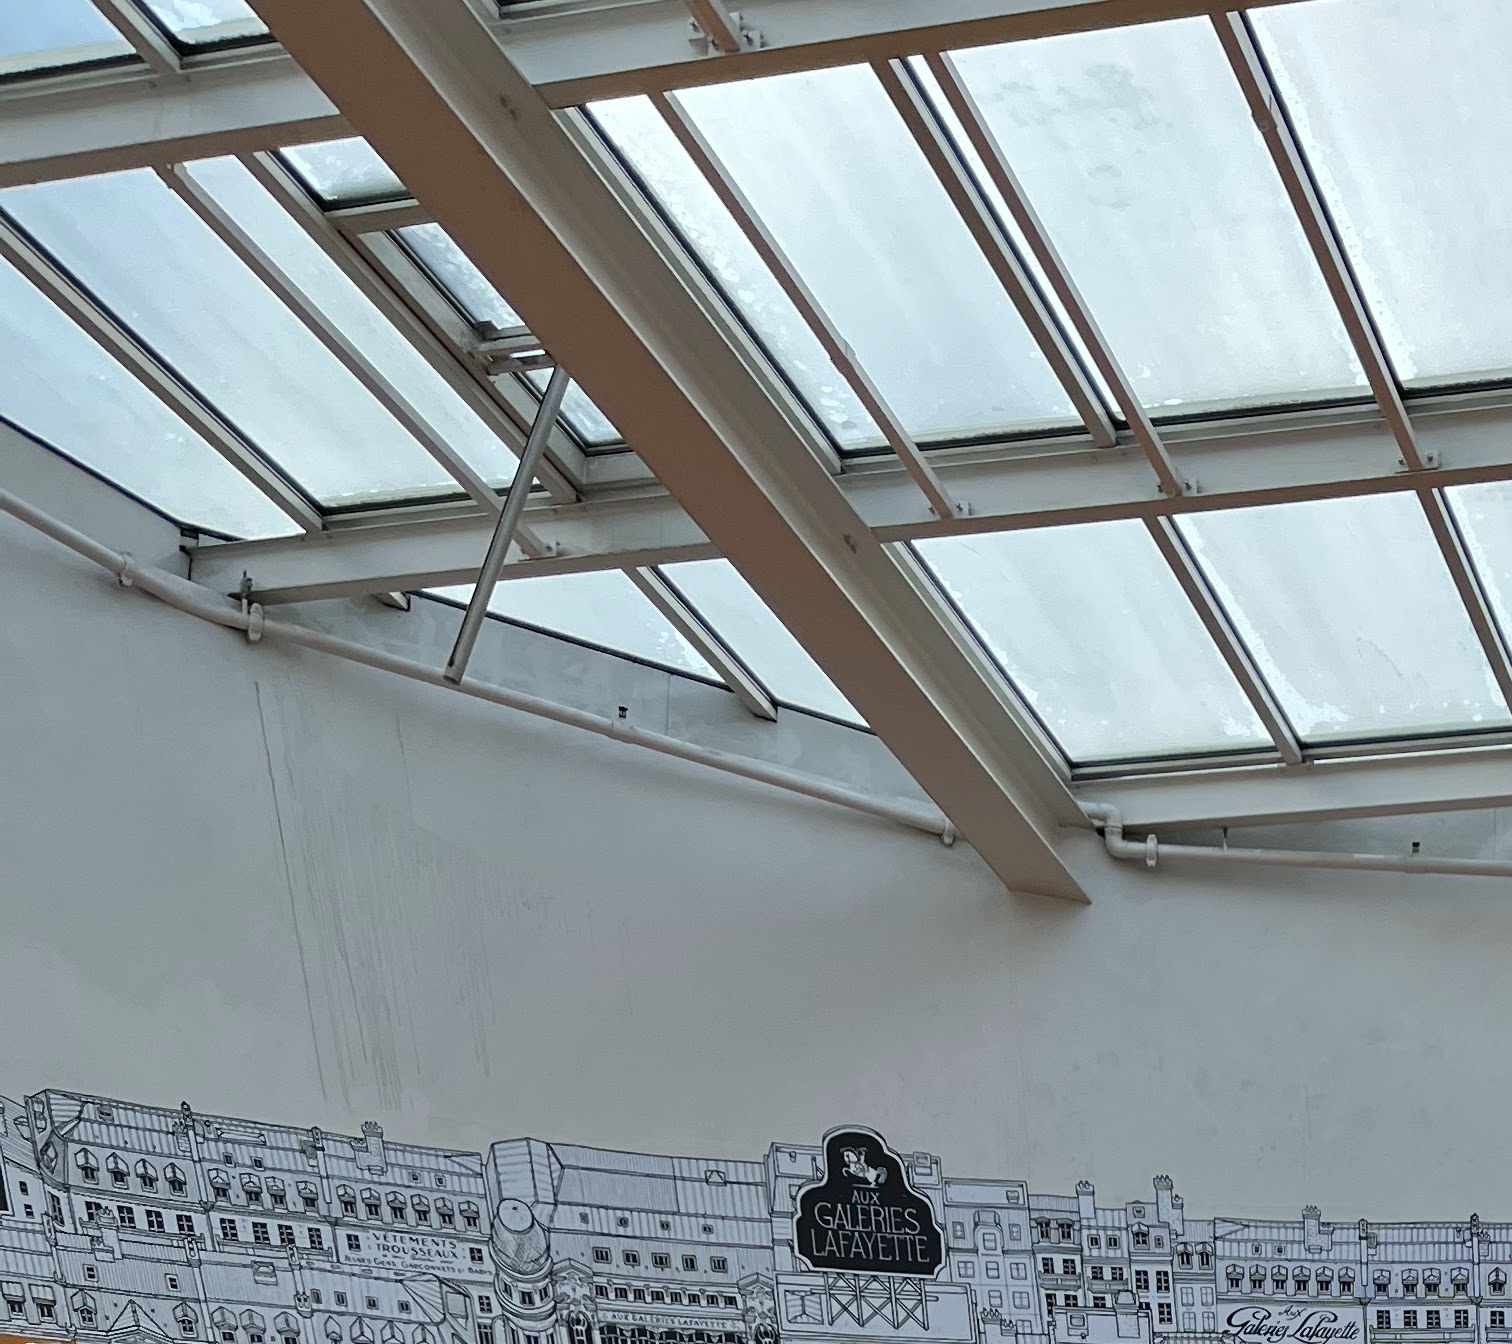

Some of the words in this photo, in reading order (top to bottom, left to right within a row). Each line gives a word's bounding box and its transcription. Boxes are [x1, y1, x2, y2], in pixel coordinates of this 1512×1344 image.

[852, 1190, 880, 1205] AUX
[814, 1202, 921, 1235] GALERIES
[376, 1243, 459, 1260] TROUSSEAUX
[810, 1229, 930, 1263] LAFAYETTE
[1226, 1306, 1290, 1343] Galeries
